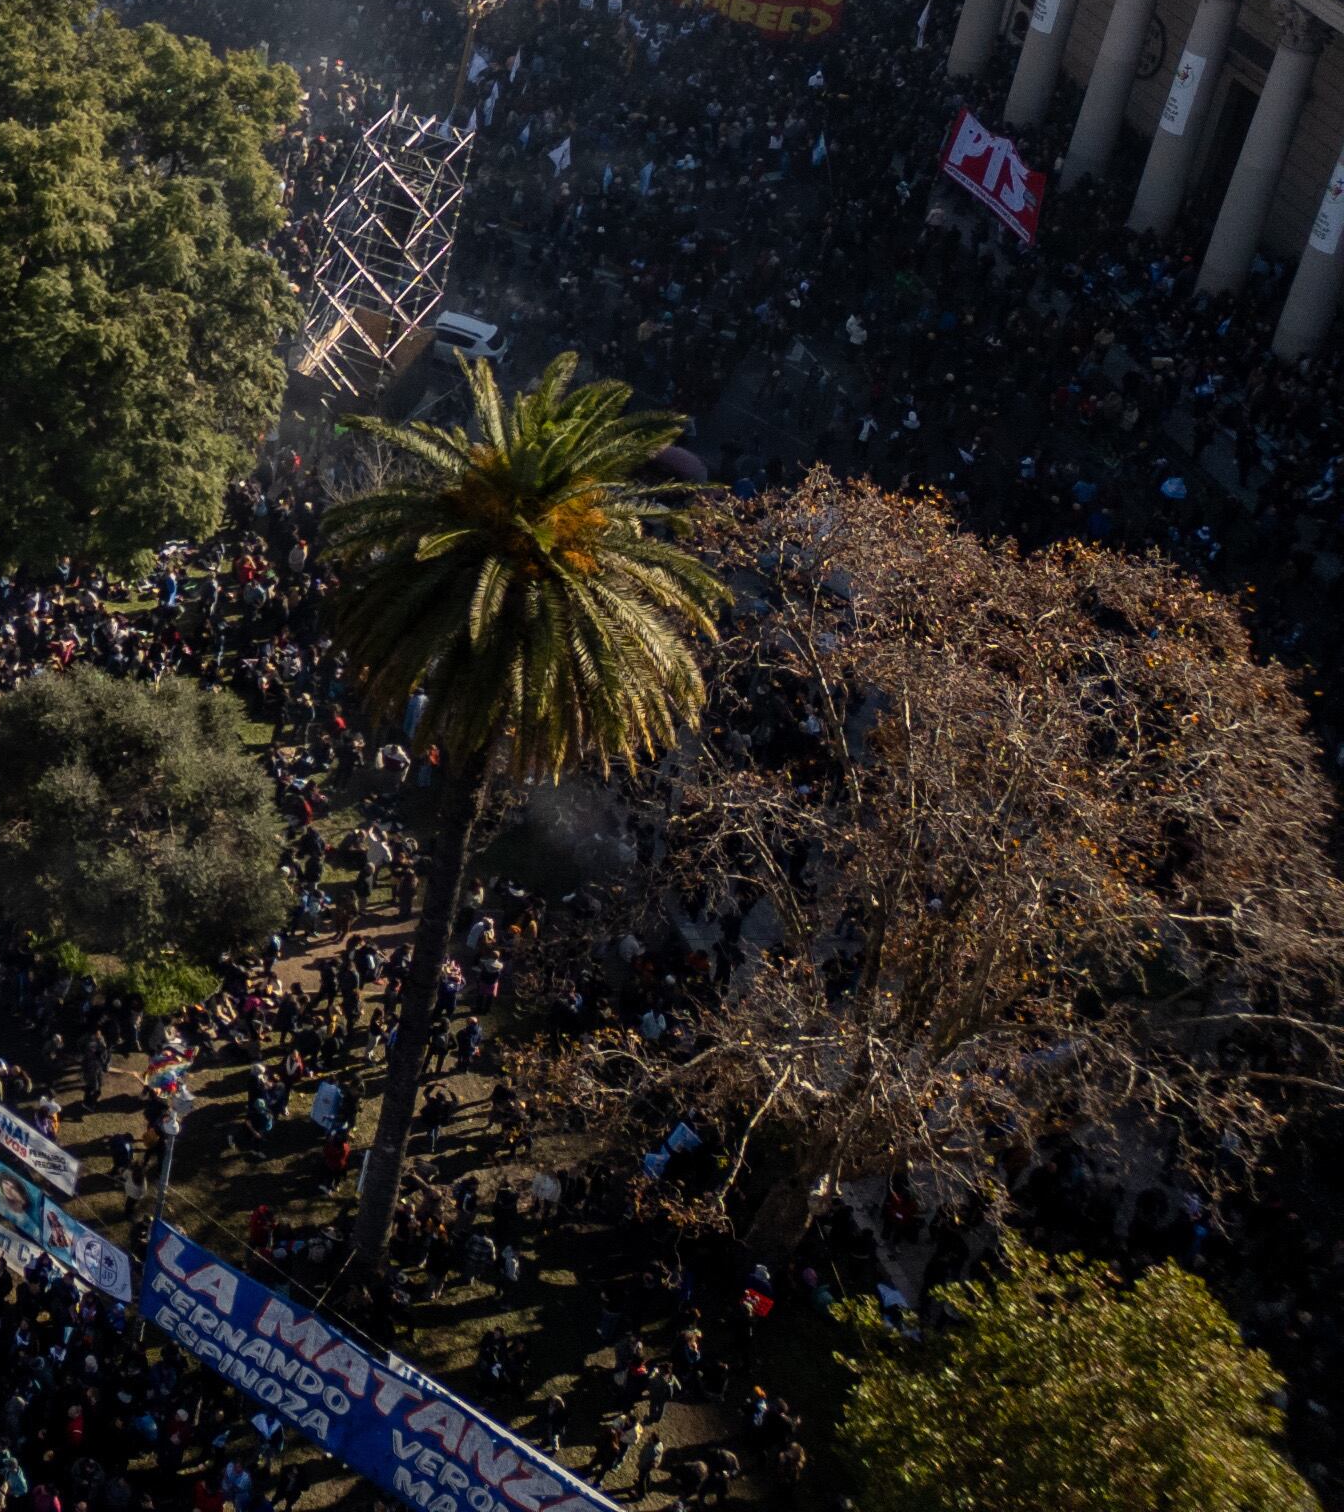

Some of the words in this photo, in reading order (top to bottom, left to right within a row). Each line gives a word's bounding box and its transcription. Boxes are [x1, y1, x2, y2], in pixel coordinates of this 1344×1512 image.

[948, 112, 1031, 213] PTS
[4, 1137, 29, 1158] VOS
[154, 1232, 241, 1317] LA
[152, 1271, 351, 1418] FERNANDO
[154, 1305, 332, 1443] ESPINOZA
